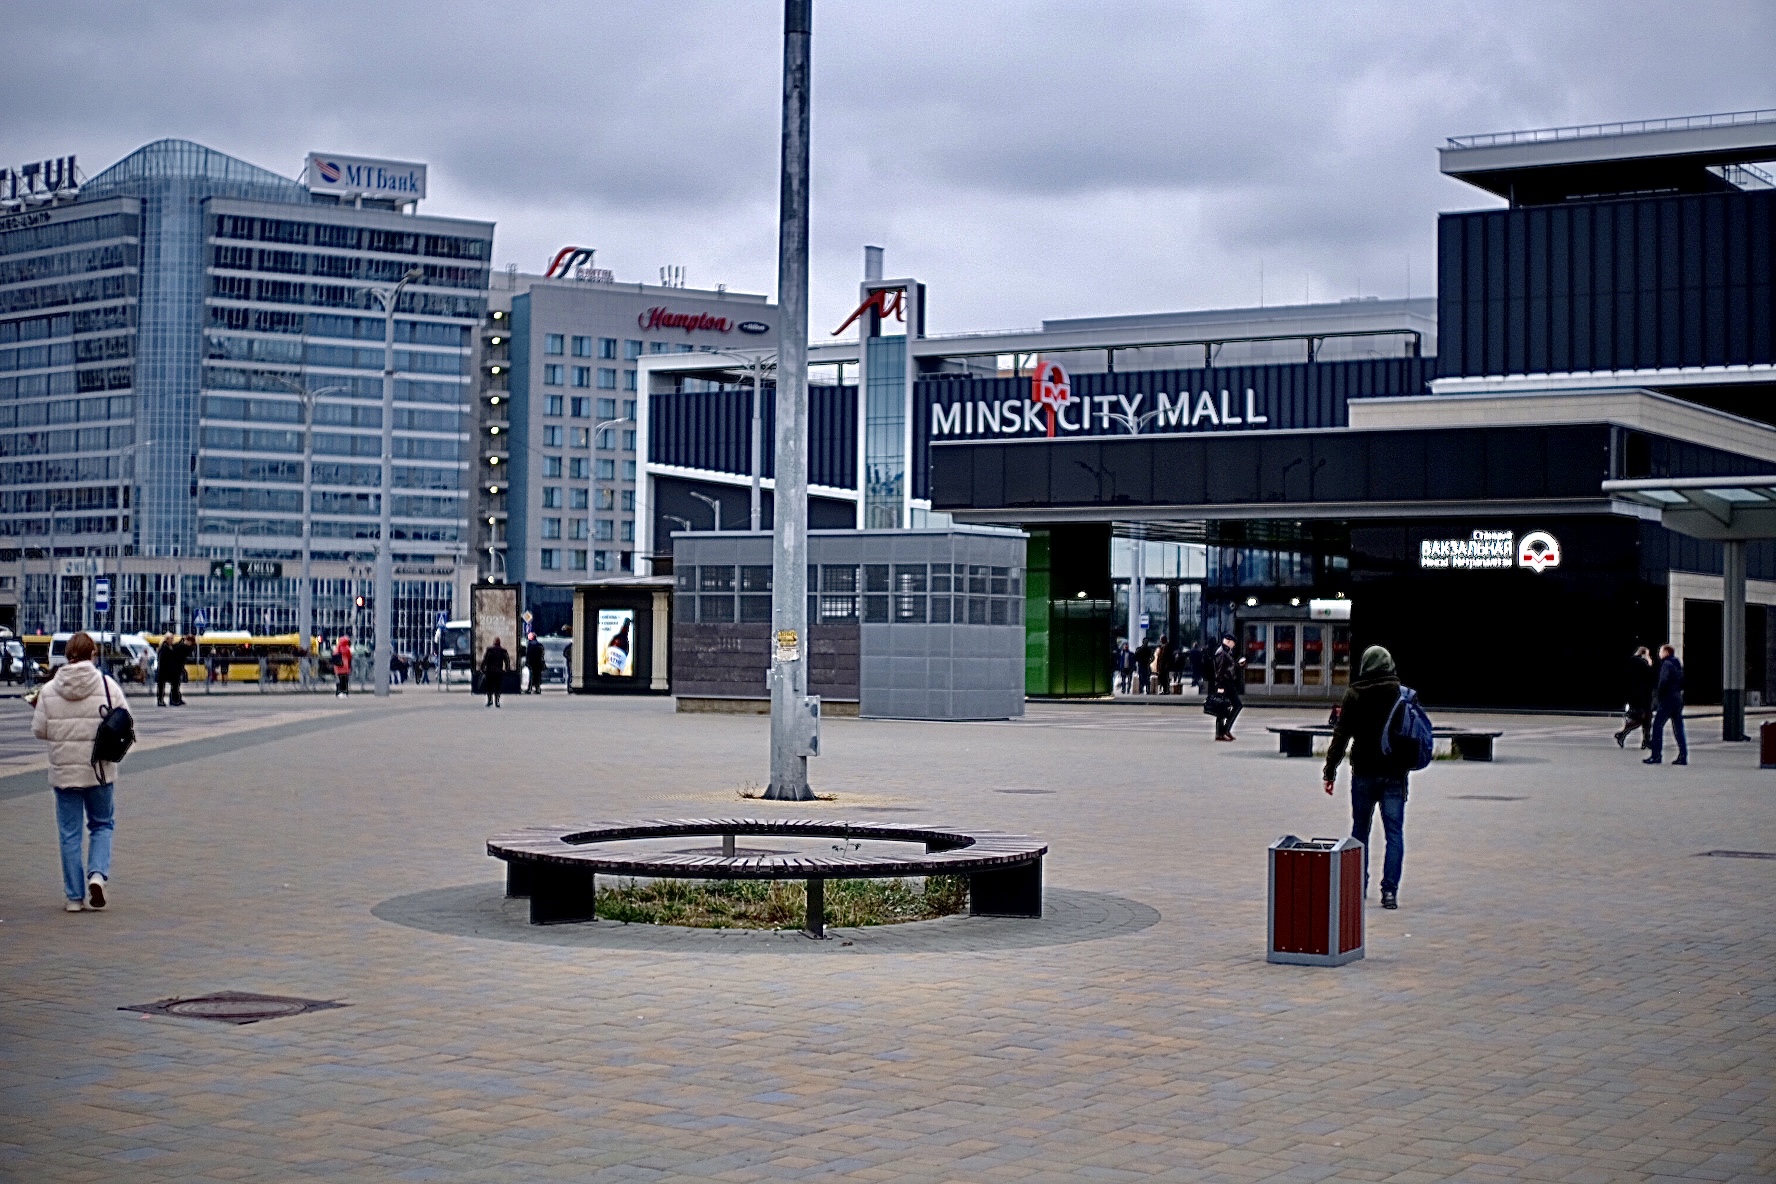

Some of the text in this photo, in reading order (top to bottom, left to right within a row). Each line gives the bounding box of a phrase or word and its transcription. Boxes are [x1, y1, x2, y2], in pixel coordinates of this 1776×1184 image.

[638, 306, 733, 333] Hampton
[931, 388, 1268, 435] MINSK CITY MALL
[1421, 540, 1513, 556] ВАКЗАЛЬНАЯ
